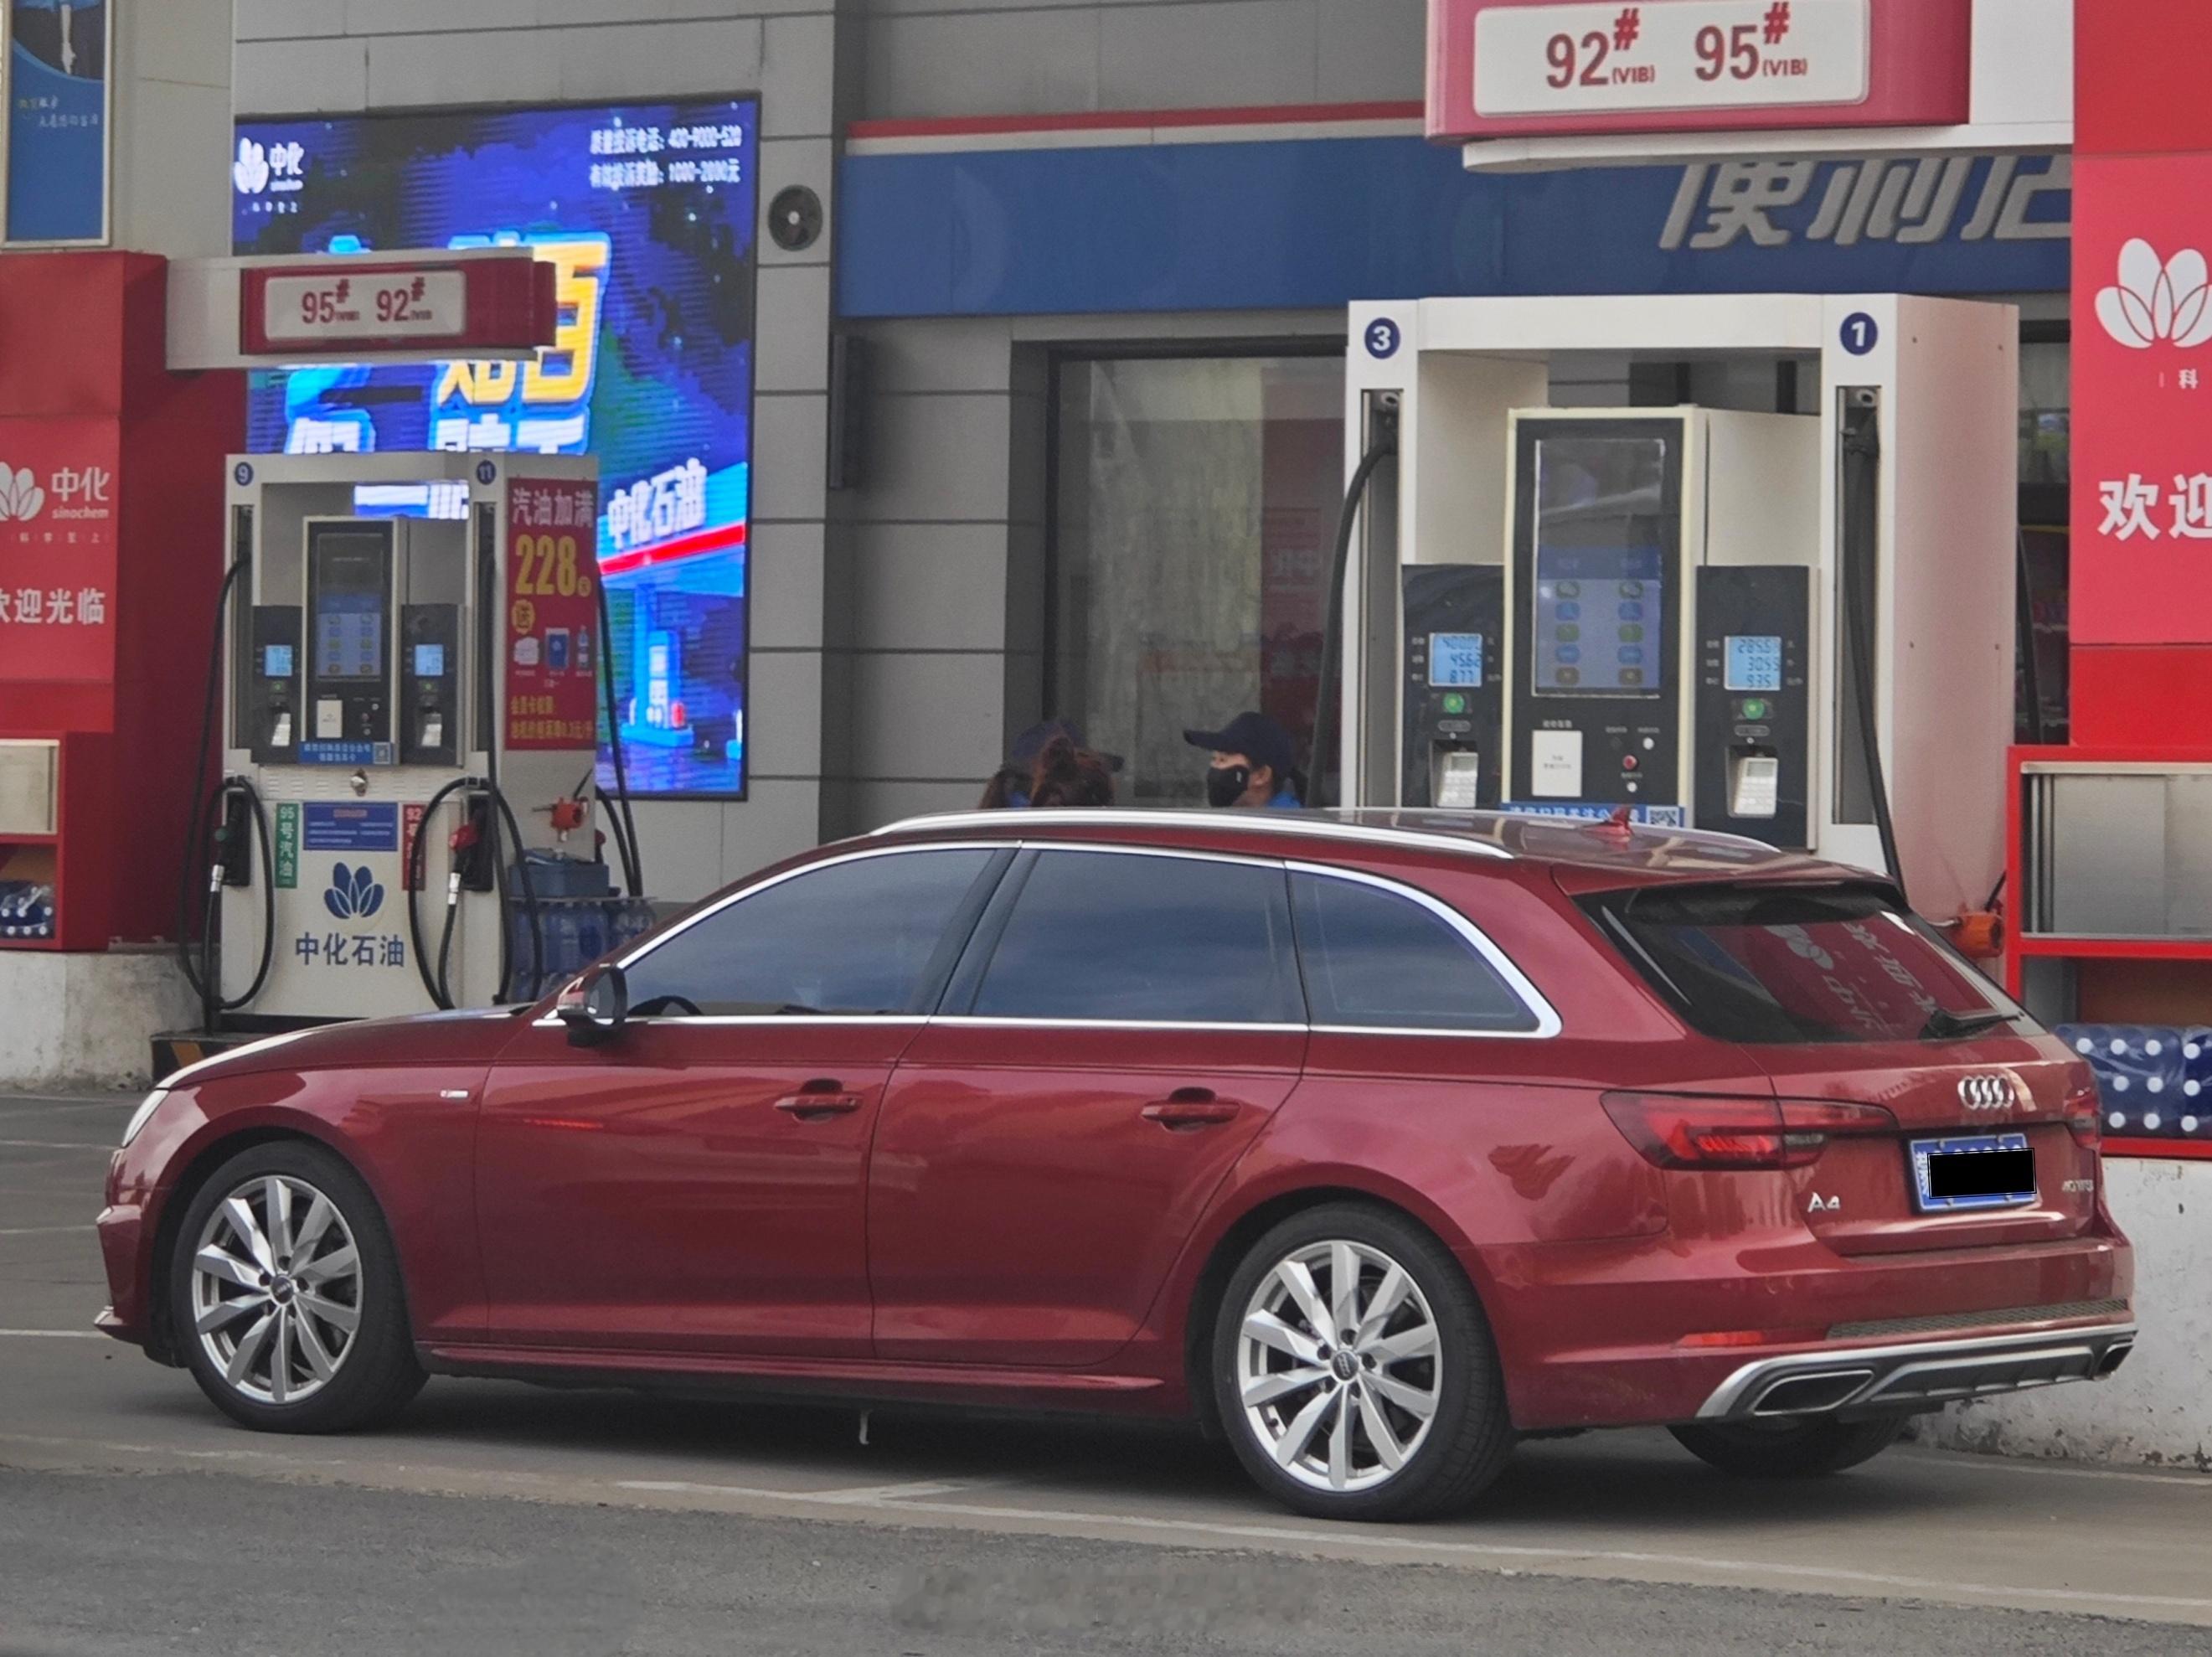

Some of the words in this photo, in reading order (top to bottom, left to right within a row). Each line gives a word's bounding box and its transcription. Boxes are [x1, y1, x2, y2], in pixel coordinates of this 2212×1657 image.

[1372, 324, 1391, 352] 3
[1851, 321, 1867, 347] 1
[51, 467, 110, 502] 中化
[512, 487, 594, 529] 汽油加满
[608, 457, 708, 550] 中化石油
[2097, 472, 2212, 541] 欢迎
[296, 932, 405, 968] 中化石油
[1807, 1191, 1841, 1213] A4
